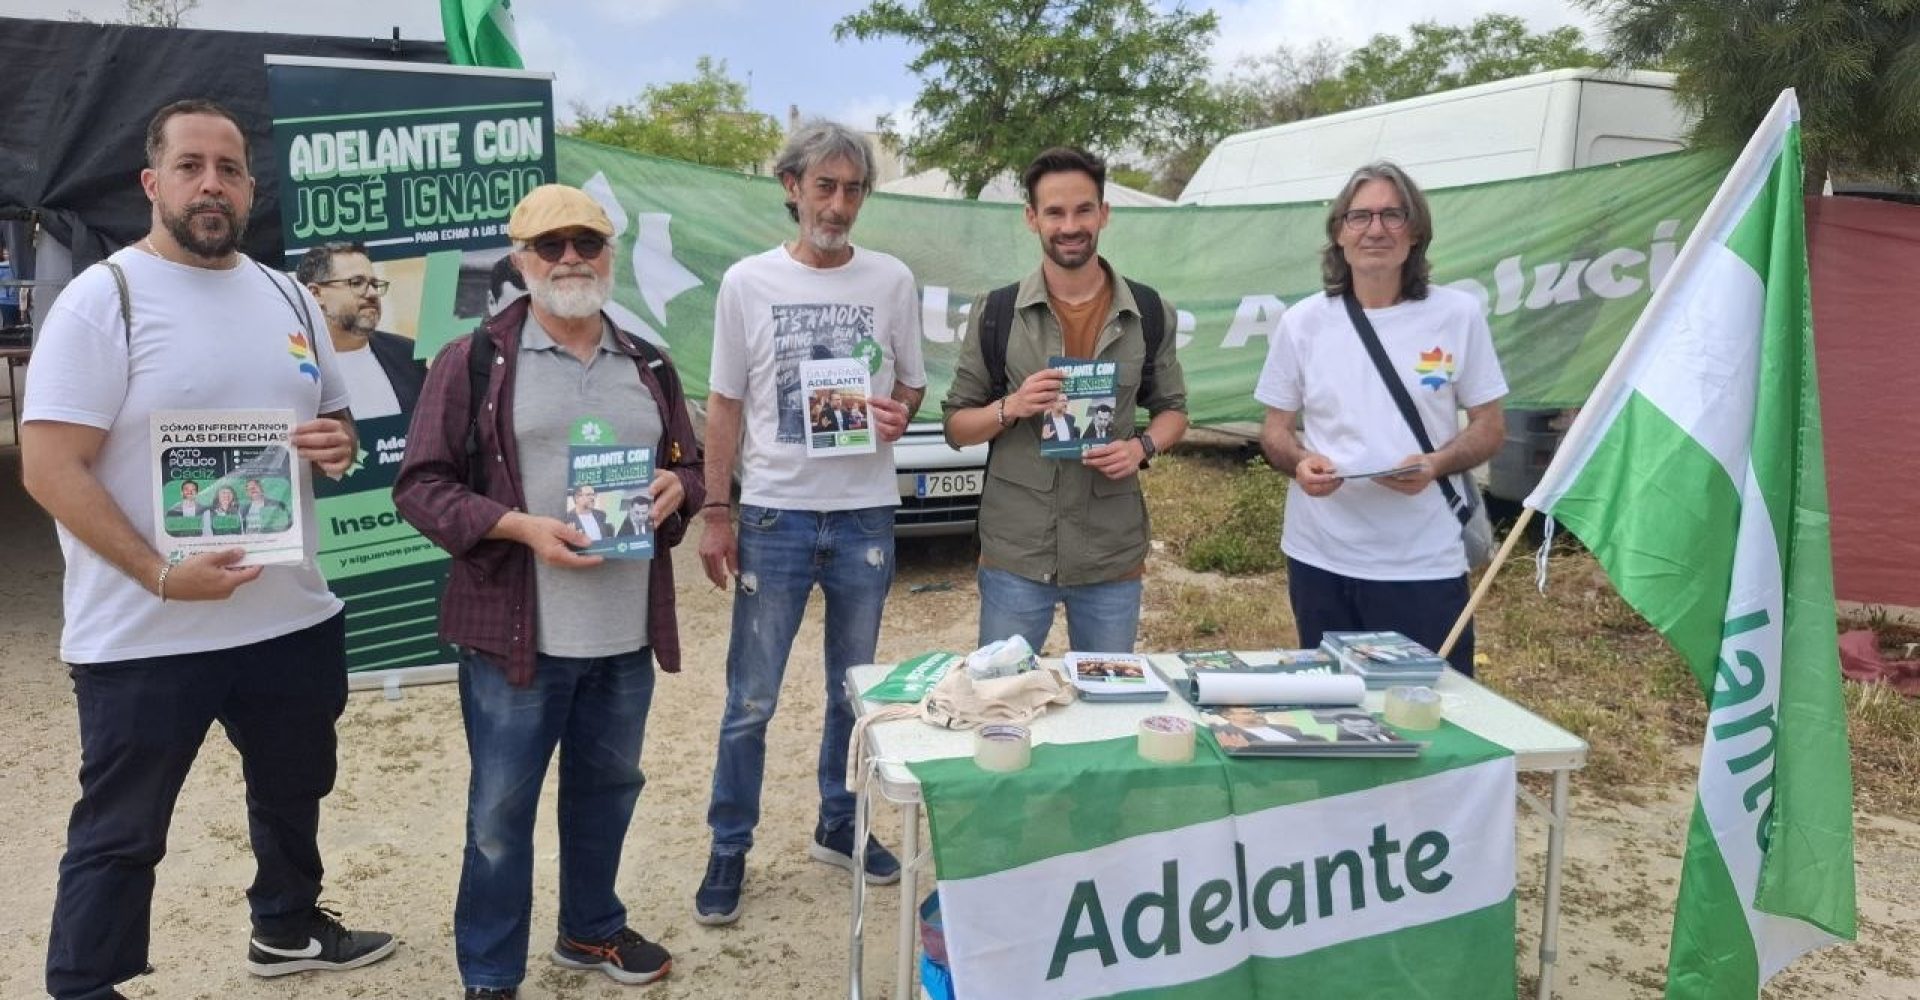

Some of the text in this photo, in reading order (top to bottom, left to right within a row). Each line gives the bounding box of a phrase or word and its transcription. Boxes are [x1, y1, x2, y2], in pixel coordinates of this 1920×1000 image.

[289, 116, 543, 181] ADELANTE CON
[294, 174, 388, 238] JOSÉ
[415, 230, 439, 243] PARA
[441, 227, 470, 240] ECHAR
[472, 226, 479, 237] A
[481, 224, 497, 237] LAS
[808, 376, 865, 386] ADELANTE
[160, 423, 289, 432] CÓMO ENFRENTARNOS
[161, 432, 288, 443] A LAS DERECHAS
[377, 436, 407, 451] Ade
[169, 449, 202, 458] ACTO
[379, 451, 405, 465] An
[574, 449, 648, 468] ADELANTE CON
[929, 474, 976, 494] 7605
[405, 543, 431, 555] para
[1045, 823, 1453, 980] Adelante
